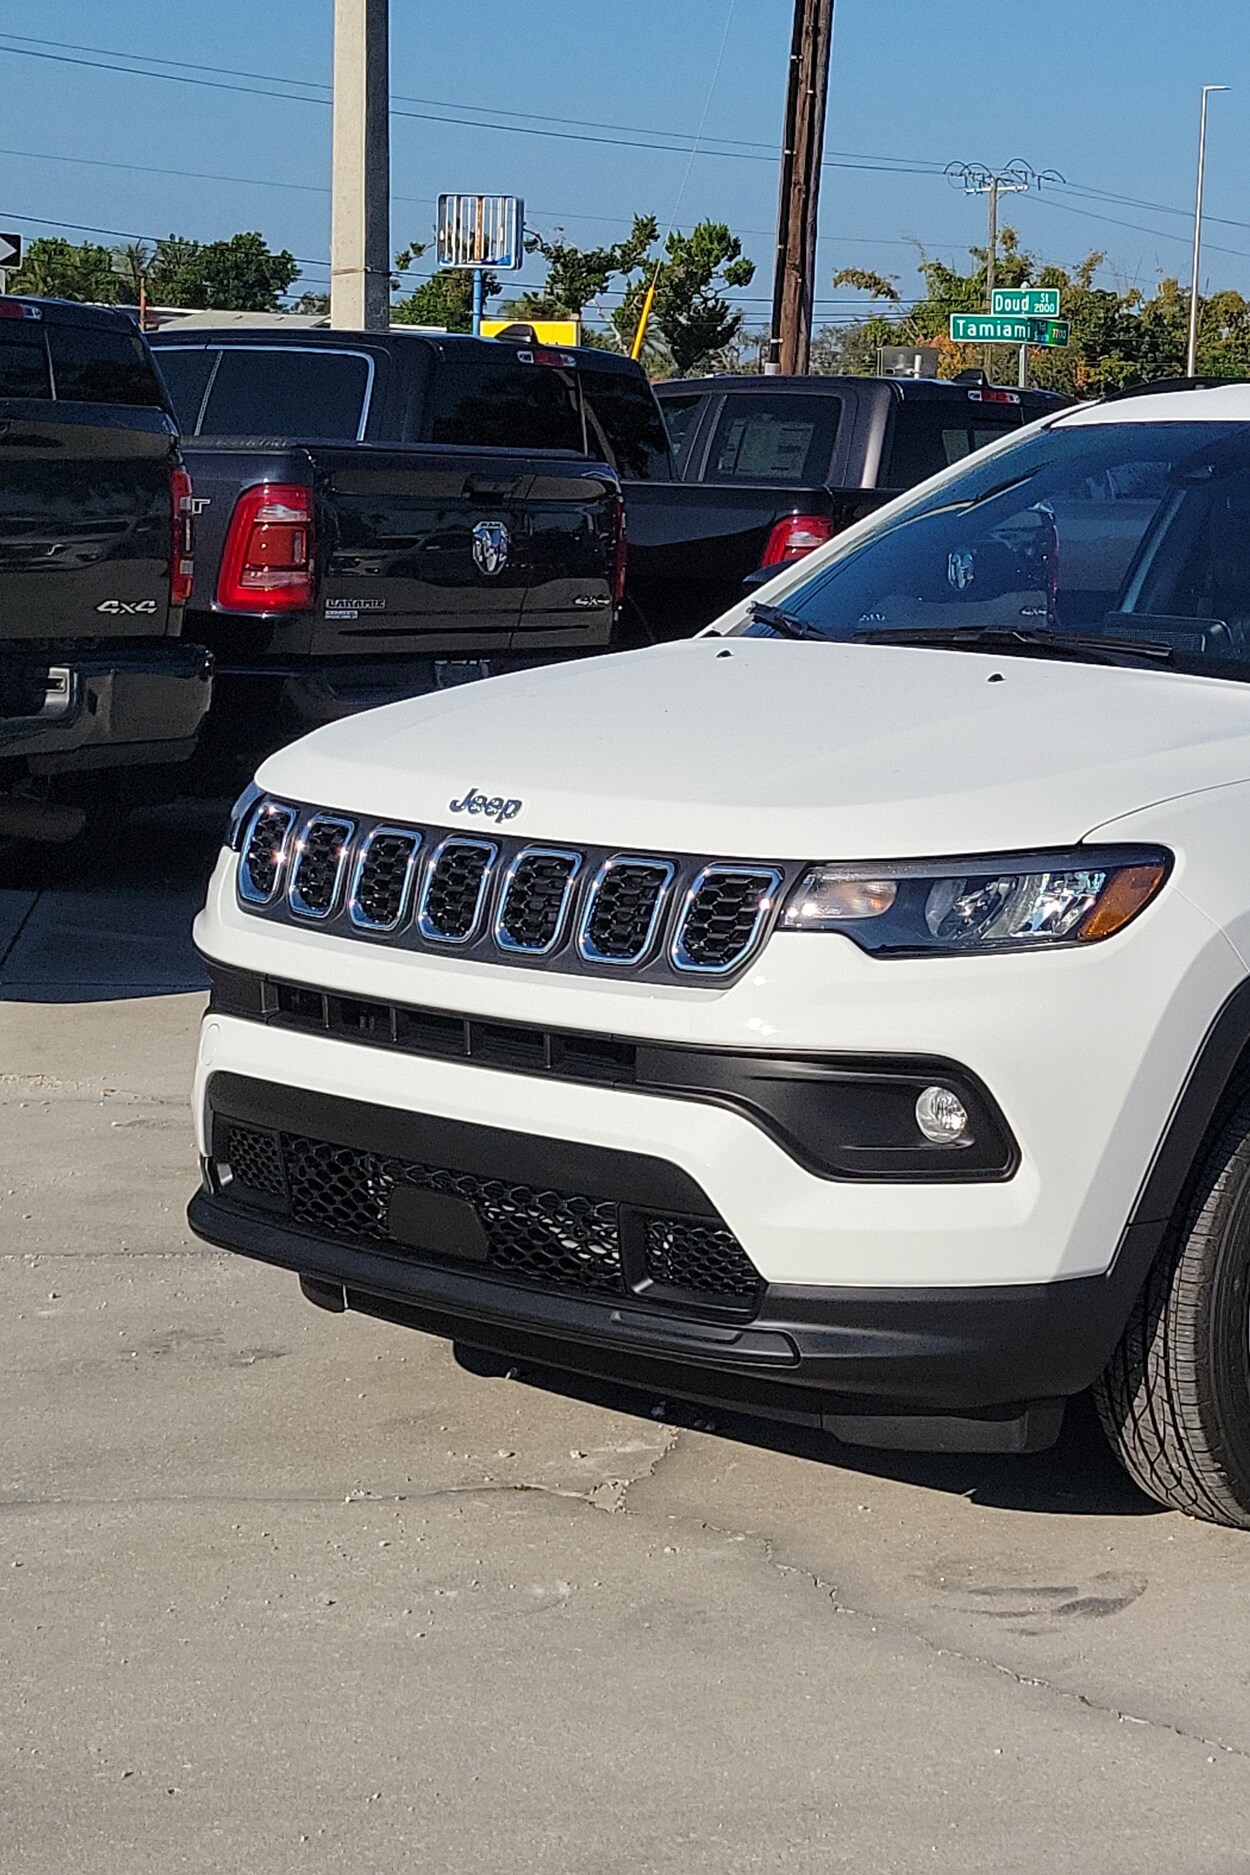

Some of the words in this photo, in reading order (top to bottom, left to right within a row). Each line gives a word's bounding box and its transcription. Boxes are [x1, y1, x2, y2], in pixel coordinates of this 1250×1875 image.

[995, 294, 1030, 312] Doud
[1040, 293, 1049, 303] St
[1033, 303, 1055, 313] 2000
[956, 319, 1031, 339] Tamiami
[449, 788, 523, 824] Jeep
